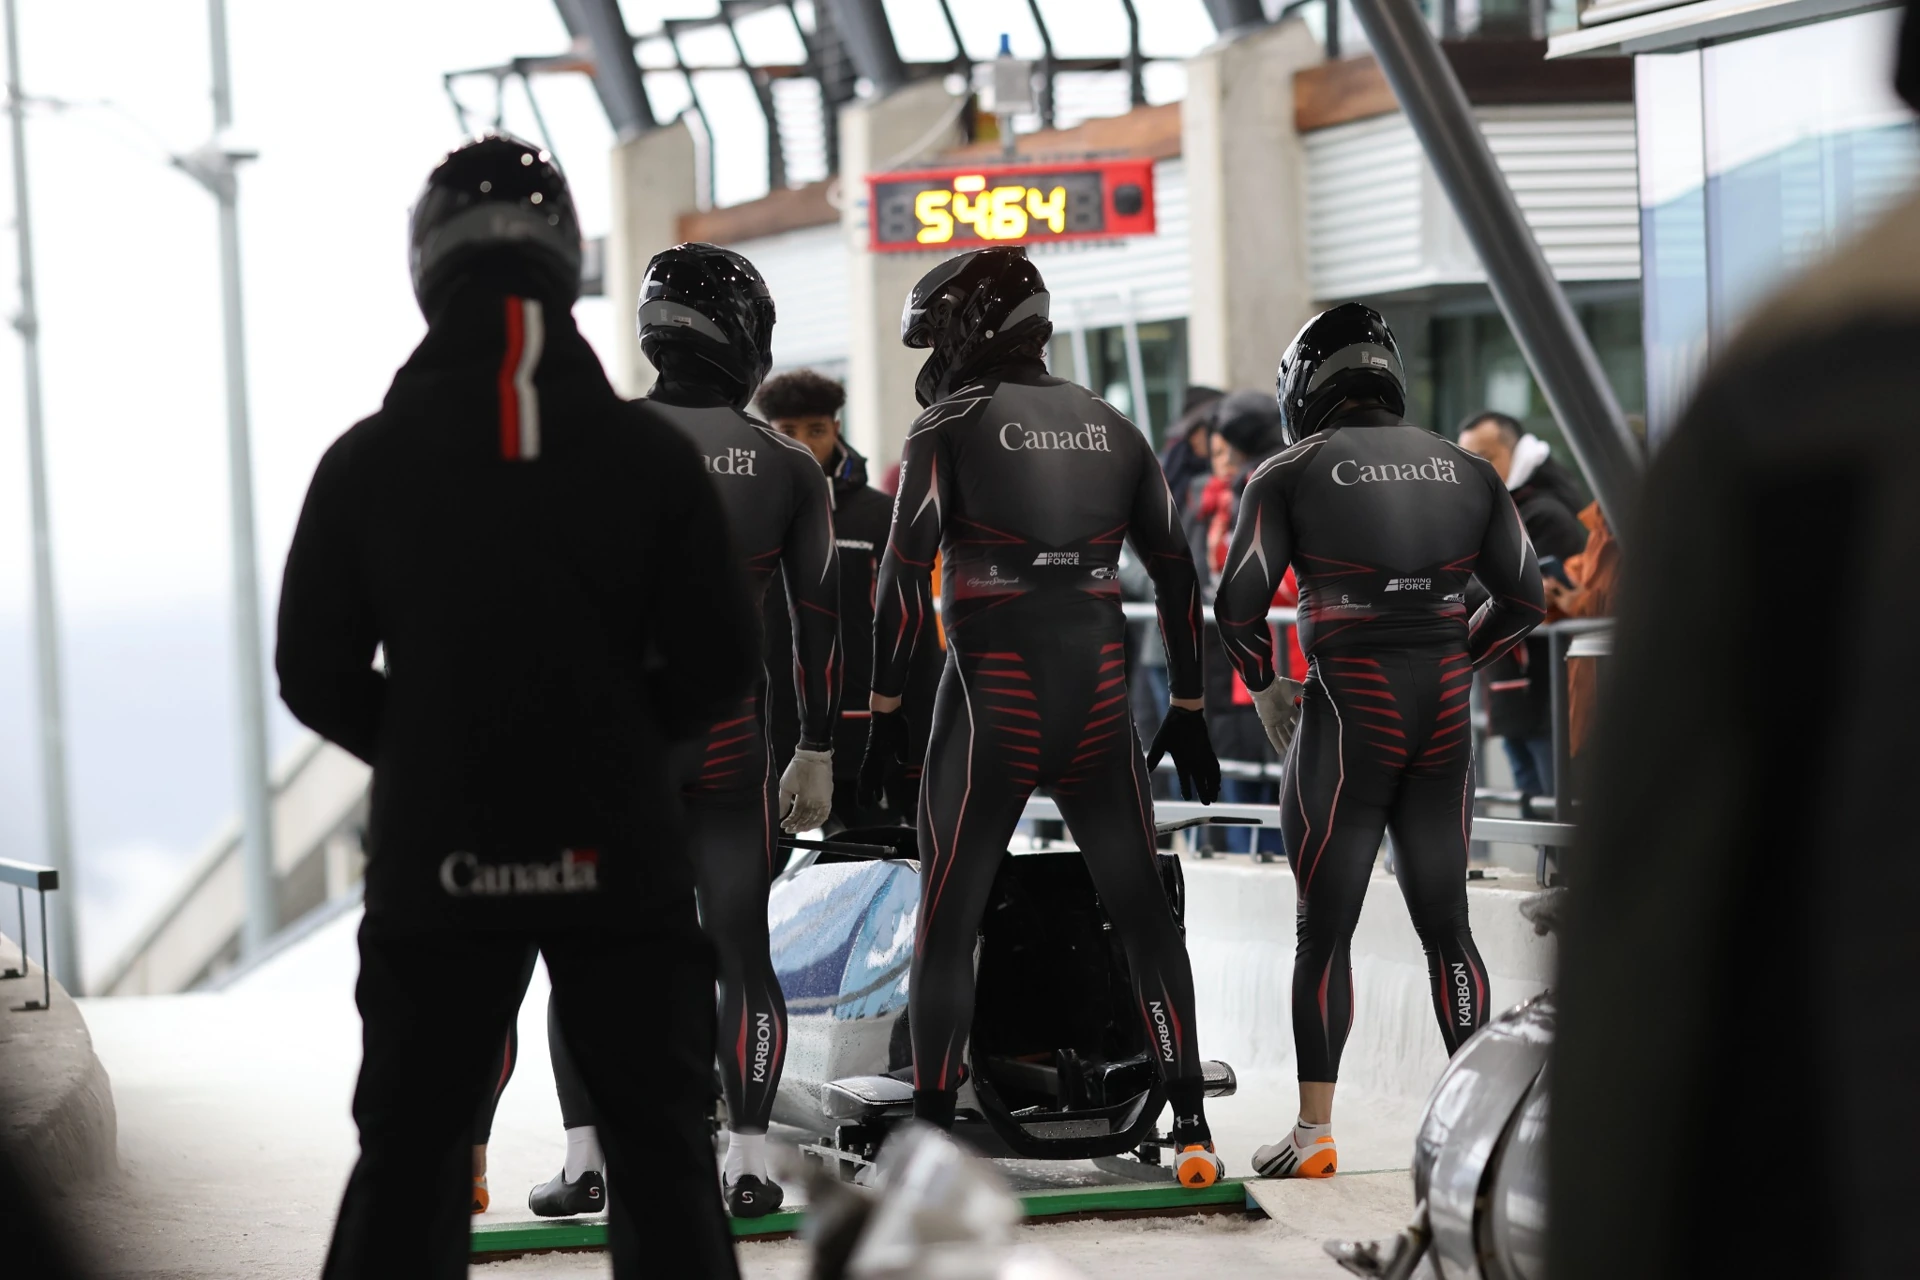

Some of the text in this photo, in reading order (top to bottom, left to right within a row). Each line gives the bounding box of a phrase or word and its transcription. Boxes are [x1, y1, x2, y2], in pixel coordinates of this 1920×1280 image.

[999, 422, 1112, 452] Canada
[1331, 457, 1461, 486] Canada
[1399, 583, 1431, 591] FORCE
[439, 848, 597, 897] Canada
[1451, 963, 1472, 1026] KARBON
[752, 1012, 771, 1083] KARBON
[1149, 1001, 1175, 1062] KARBON
